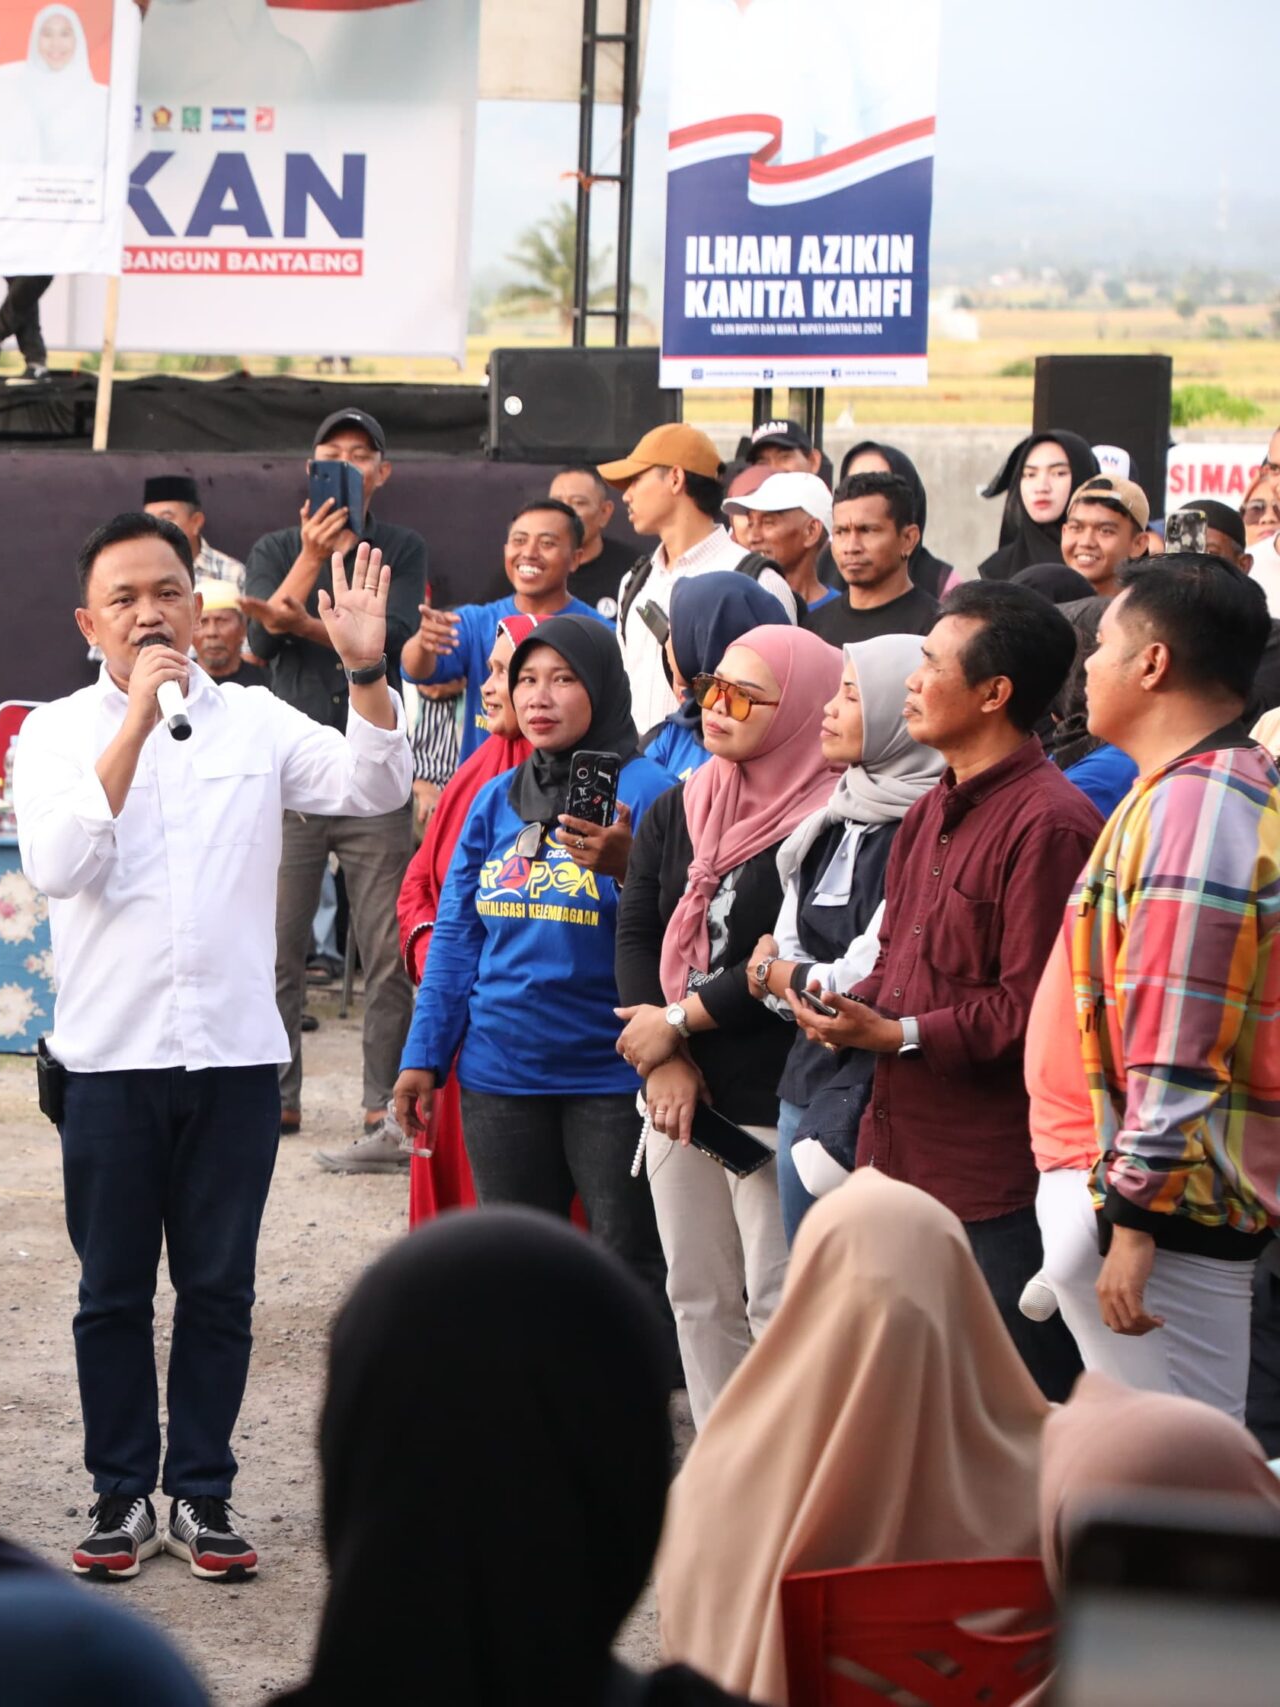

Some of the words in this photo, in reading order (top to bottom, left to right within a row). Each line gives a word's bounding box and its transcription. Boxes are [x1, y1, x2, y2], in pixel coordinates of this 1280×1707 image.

[226, 252, 359, 273] BANTAENG
[685, 235, 792, 275] ILHAM
[797, 234, 914, 275] AZIKIN
[684, 279, 806, 318] KANITA
[812, 279, 912, 318] KAHFI
[528, 903, 600, 926] KELEMBAGAAN
